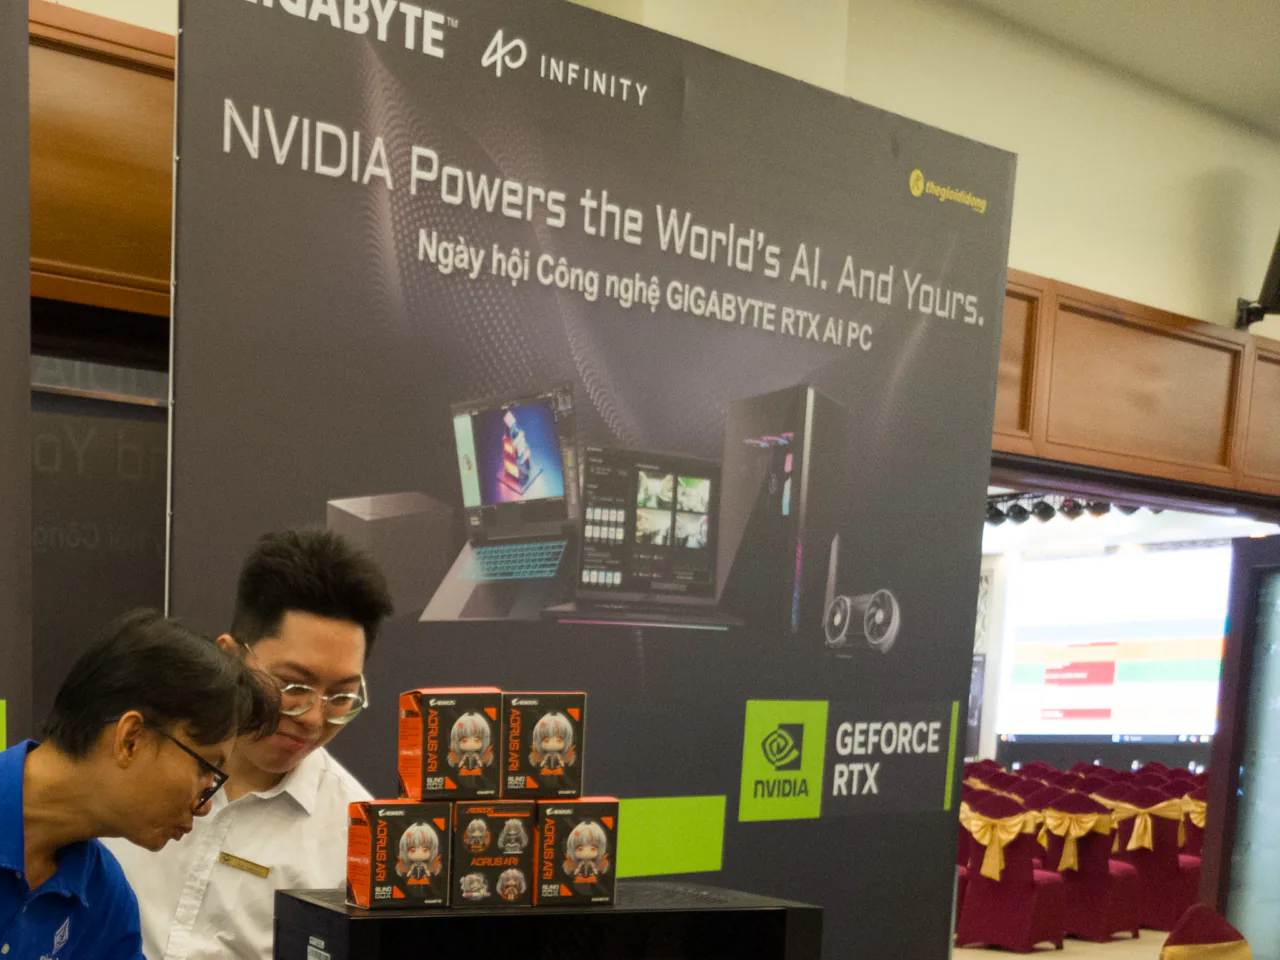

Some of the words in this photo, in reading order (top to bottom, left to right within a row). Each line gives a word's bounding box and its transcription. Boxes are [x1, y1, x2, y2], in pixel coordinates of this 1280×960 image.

[245, 0, 455, 59] ABYTE
[540, 54, 649, 107] INFINITY
[223, 98, 394, 190] NVIDIA
[410, 145, 567, 229] Powers
[580, 188, 644, 246] the
[656, 204, 781, 279] World's
[789, 243, 828, 290] AI.
[837, 255, 894, 305] And
[903, 268, 985, 327] Yours.
[418, 229, 486, 280] Ngày
[491, 244, 530, 287] hội
[536, 254, 600, 302] Công
[605, 273, 661, 313] nghệ
[666, 280, 777, 332] GIGABYTE
[780, 306, 821, 341] RTX
[823, 320, 844, 346] AI
[847, 322, 873, 351] PC
[835, 722, 942, 756] GEFORCE
[832, 763, 880, 797] RTX
